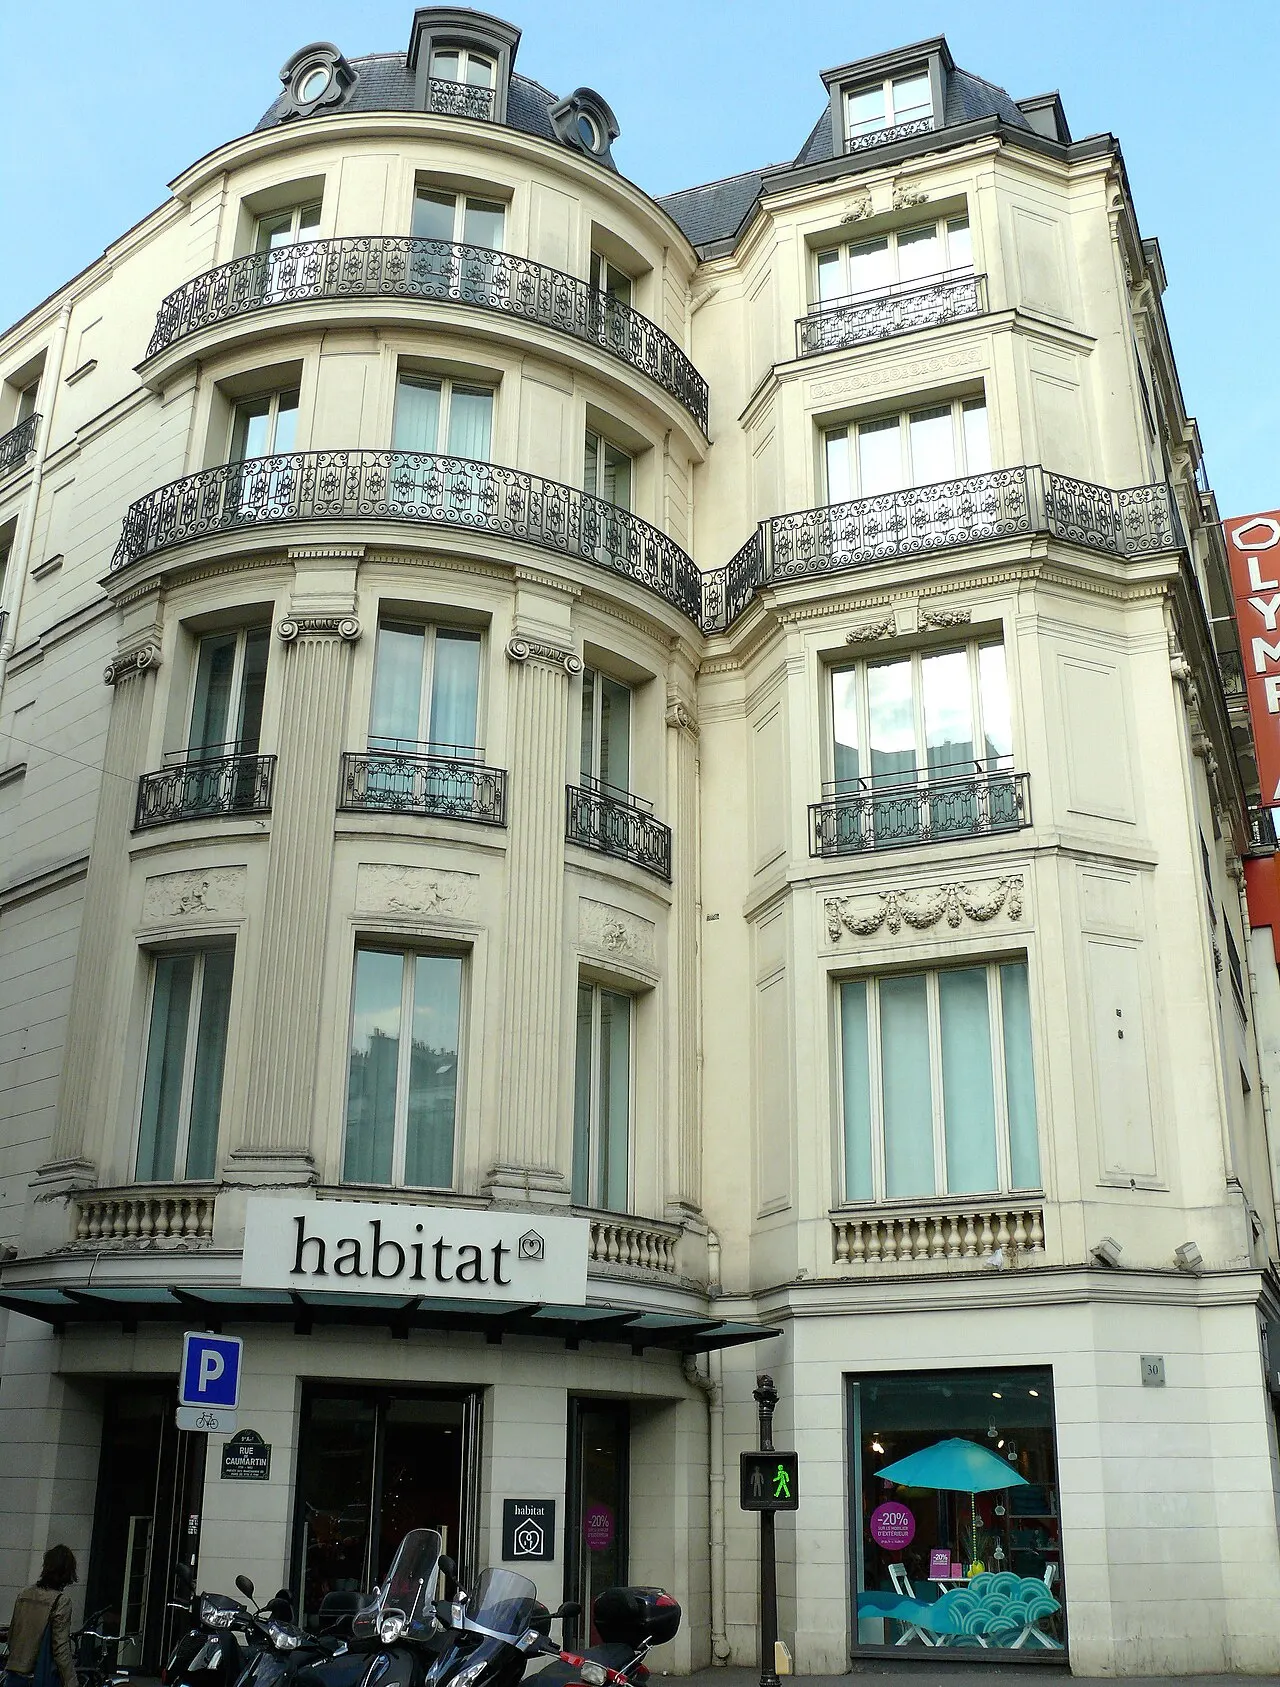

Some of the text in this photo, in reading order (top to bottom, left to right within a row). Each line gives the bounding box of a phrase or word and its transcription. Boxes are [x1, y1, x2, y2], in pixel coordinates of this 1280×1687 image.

[289, 1215, 512, 1285] habitat
[198, 1349, 225, 1392] P
[1147, 1364, 1159, 1376] 30
[239, 1446, 254, 1454] RUE
[225, 1457, 267, 1466] CAUMARTIN
[514, 1504, 545, 1516] habitat
[588, 1515, 610, 1527] -20%
[877, 1512, 909, 1526] -20%
